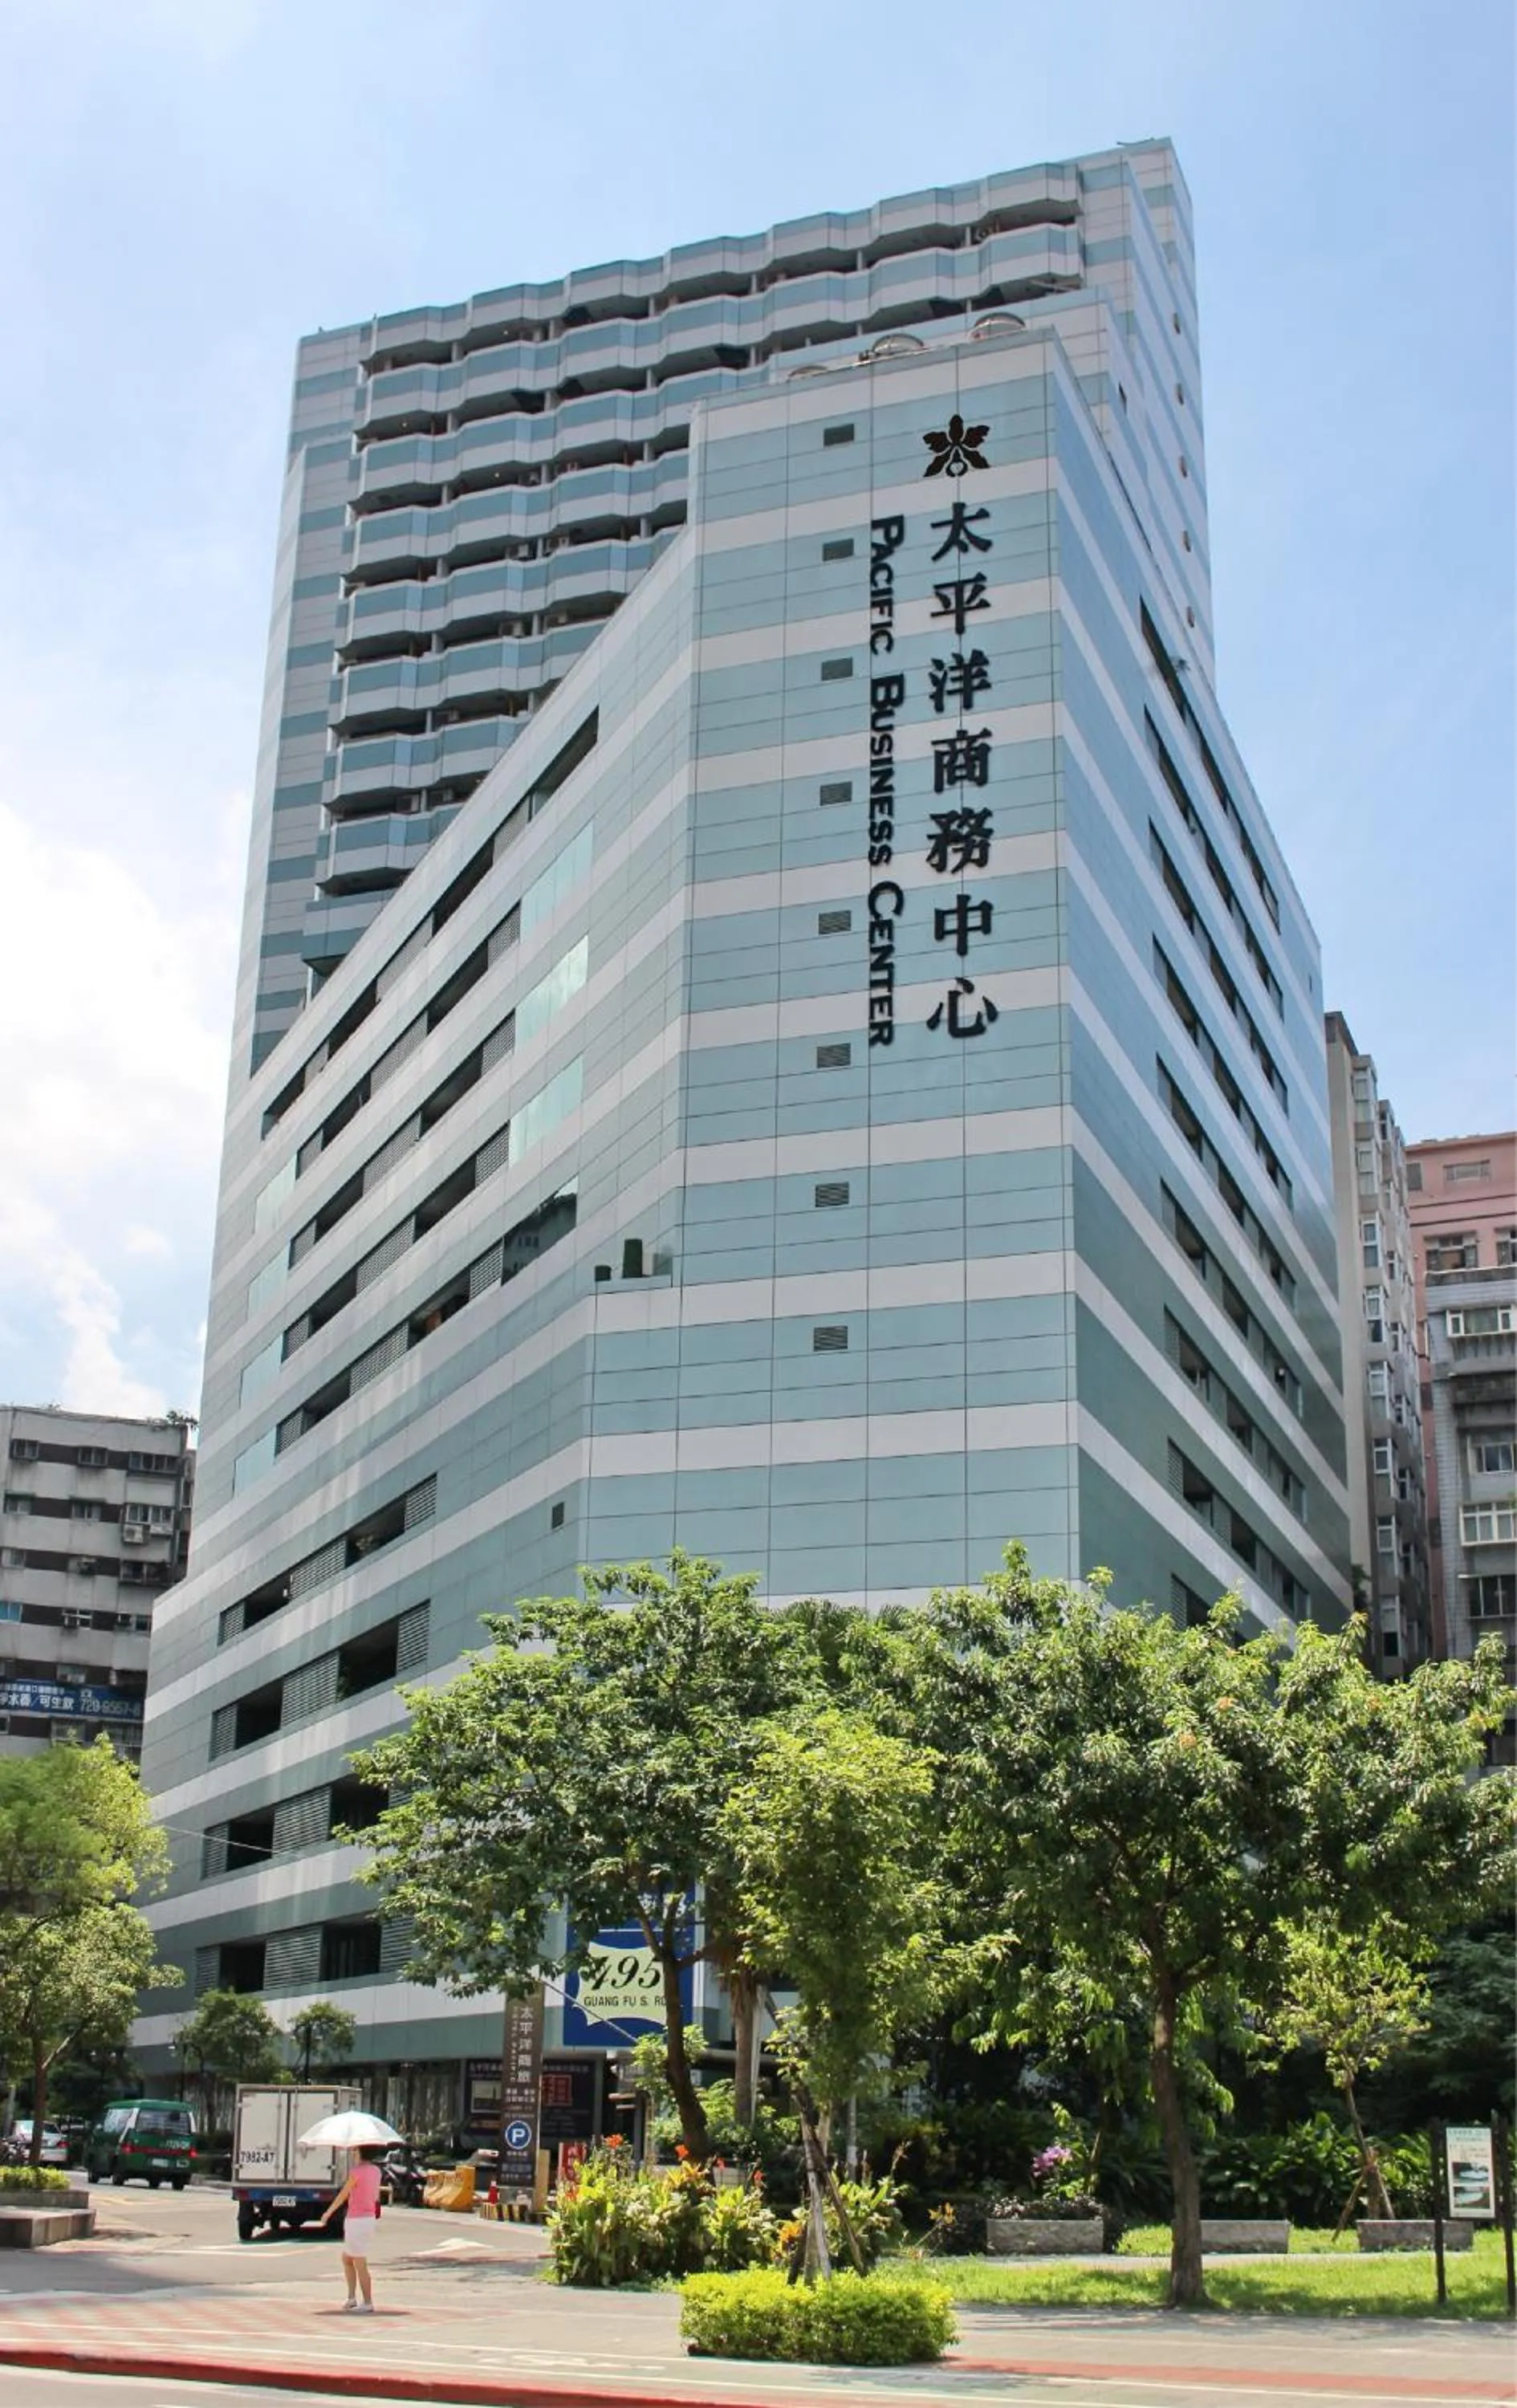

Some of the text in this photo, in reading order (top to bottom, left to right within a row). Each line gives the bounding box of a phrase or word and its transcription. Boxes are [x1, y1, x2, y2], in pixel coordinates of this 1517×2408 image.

[868, 514, 905, 1047] PACIFIC BUSINESS CENTER
[926, 502, 998, 1039] 太平洋商務中心
[584, 1995, 619, 2007] GUANG
